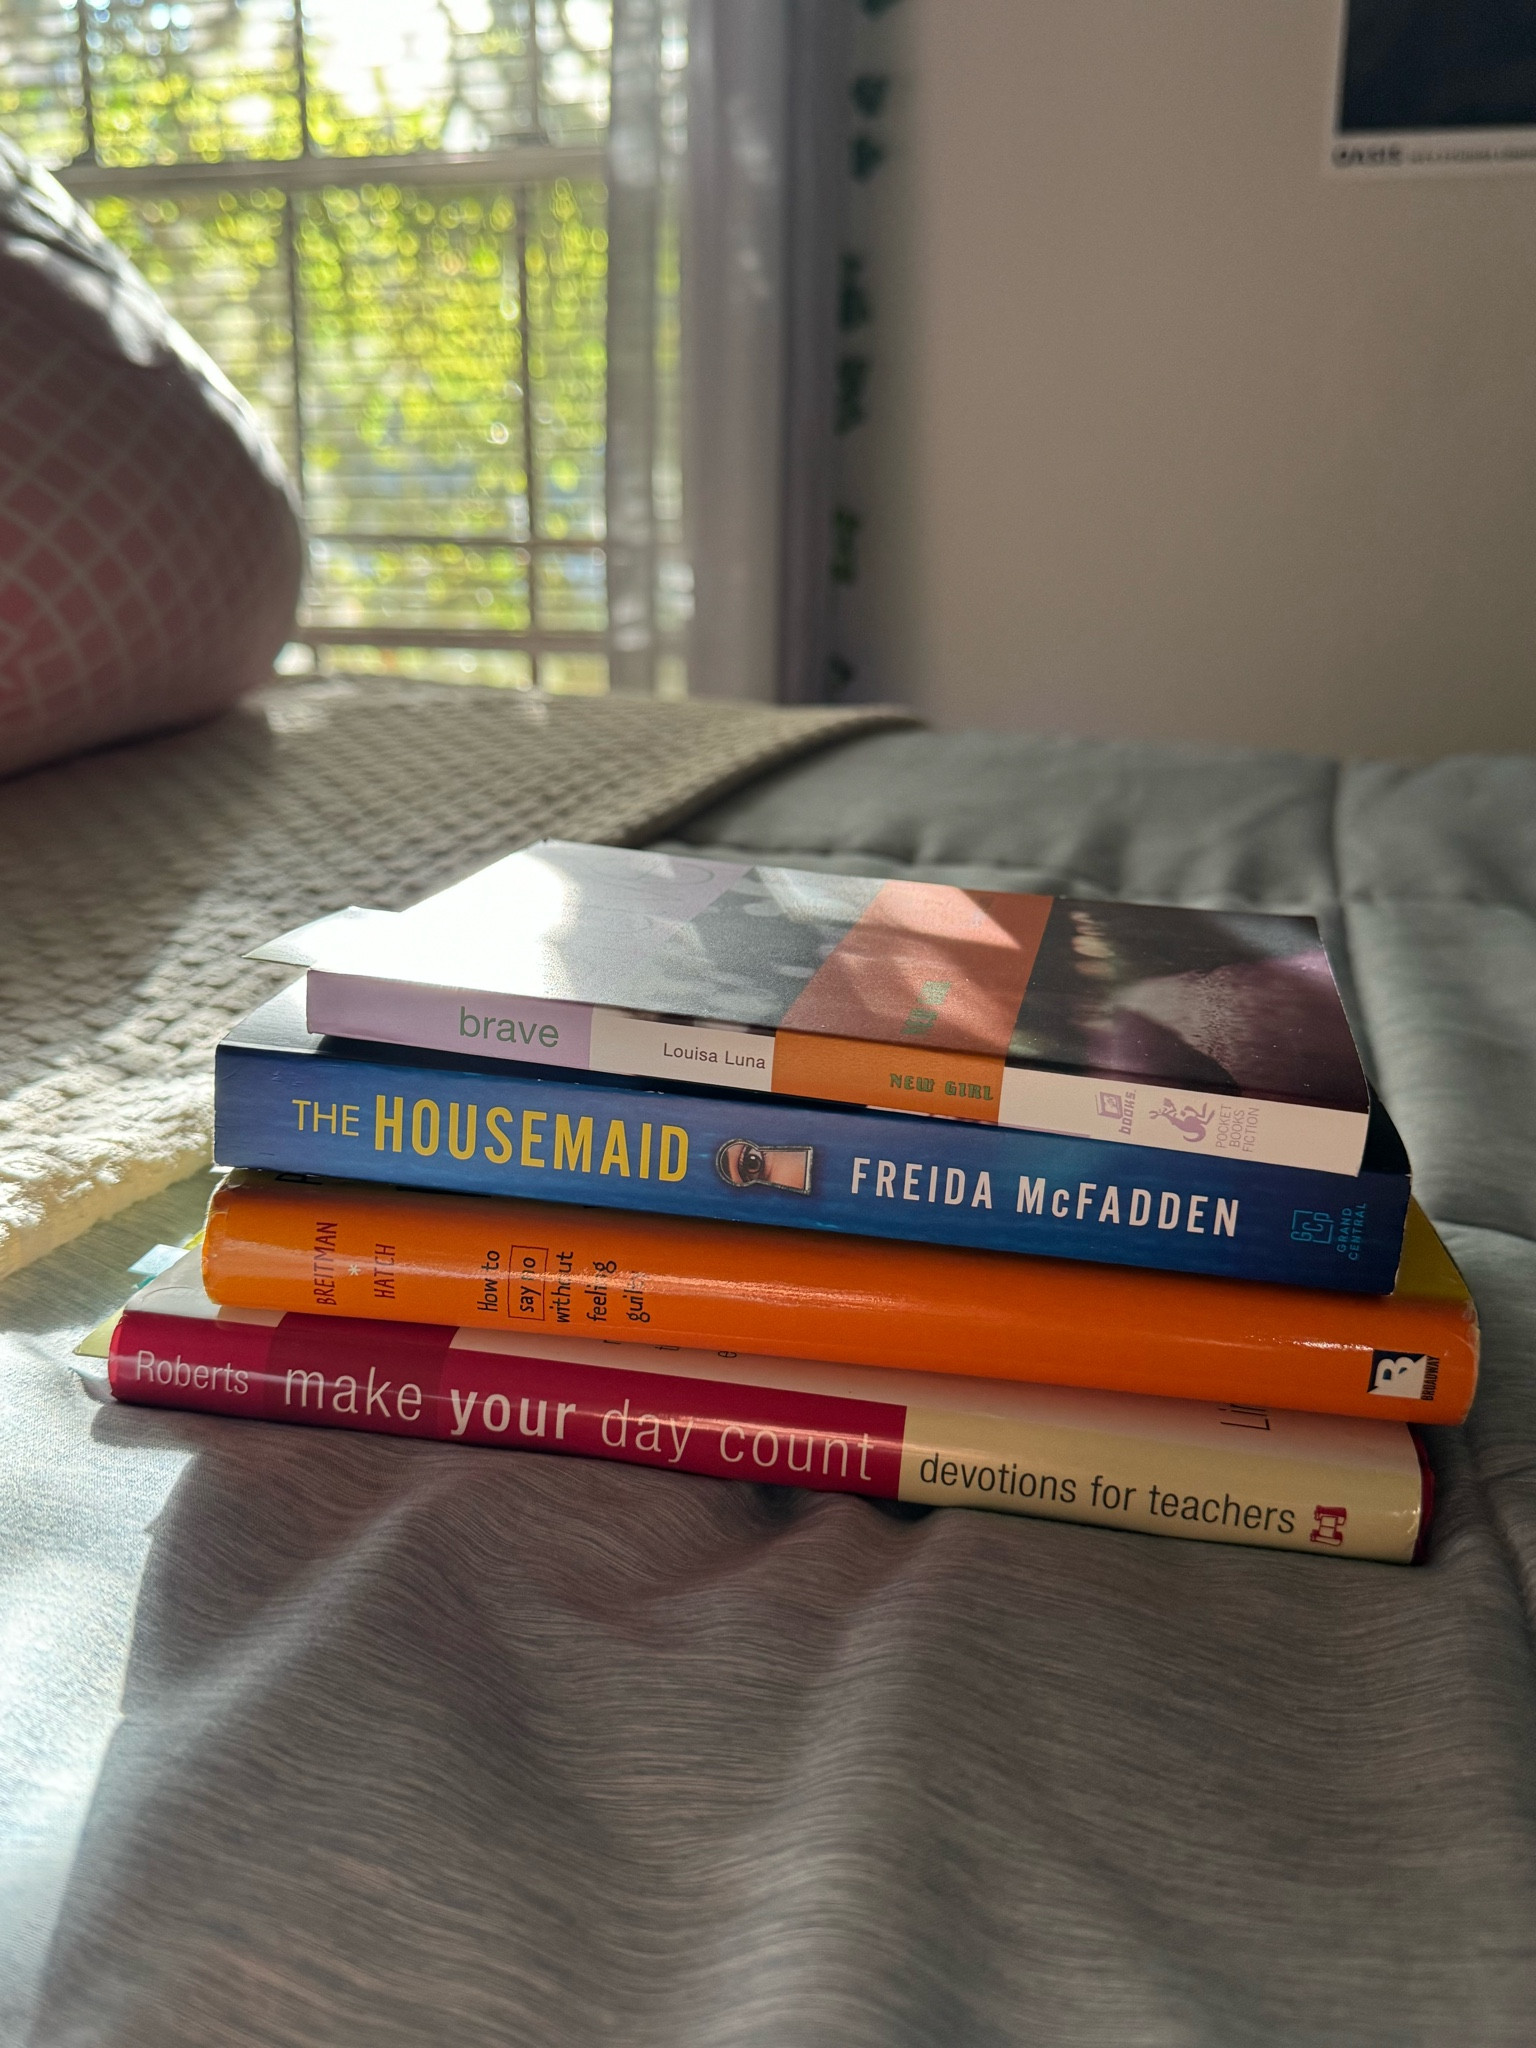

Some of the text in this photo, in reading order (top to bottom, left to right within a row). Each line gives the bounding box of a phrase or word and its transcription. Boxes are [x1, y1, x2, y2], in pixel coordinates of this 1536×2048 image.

[459, 1006, 559, 1047] brave
[663, 1042, 766, 1070] Louisa Luna
[889, 1073, 994, 1101] NEW GIRL
[292, 1094, 689, 1182] THE HOUSEMAID
[1216, 1103, 1232, 1148] POCKET
[1229, 1109, 1245, 1148] BOOKS
[1242, 1107, 1260, 1152] FICTION
[851, 1157, 1239, 1237] FREIDA McFADDEN
[1336, 1207, 1352, 1253] GRAND
[1348, 1203, 1367, 1261] CENTRAL
[313, 1222, 338, 1305] BREITMAN
[374, 1243, 396, 1299] HATCH
[477, 1250, 500, 1312] How to
[520, 1257, 541, 1312] say no
[622, 1271, 650, 1323] guil
[1420, 1355, 1440, 1401] BROADWAY
[136, 1350, 874, 1481] Roberts make your day count
[919, 1453, 1296, 1534] devotions for teachers
